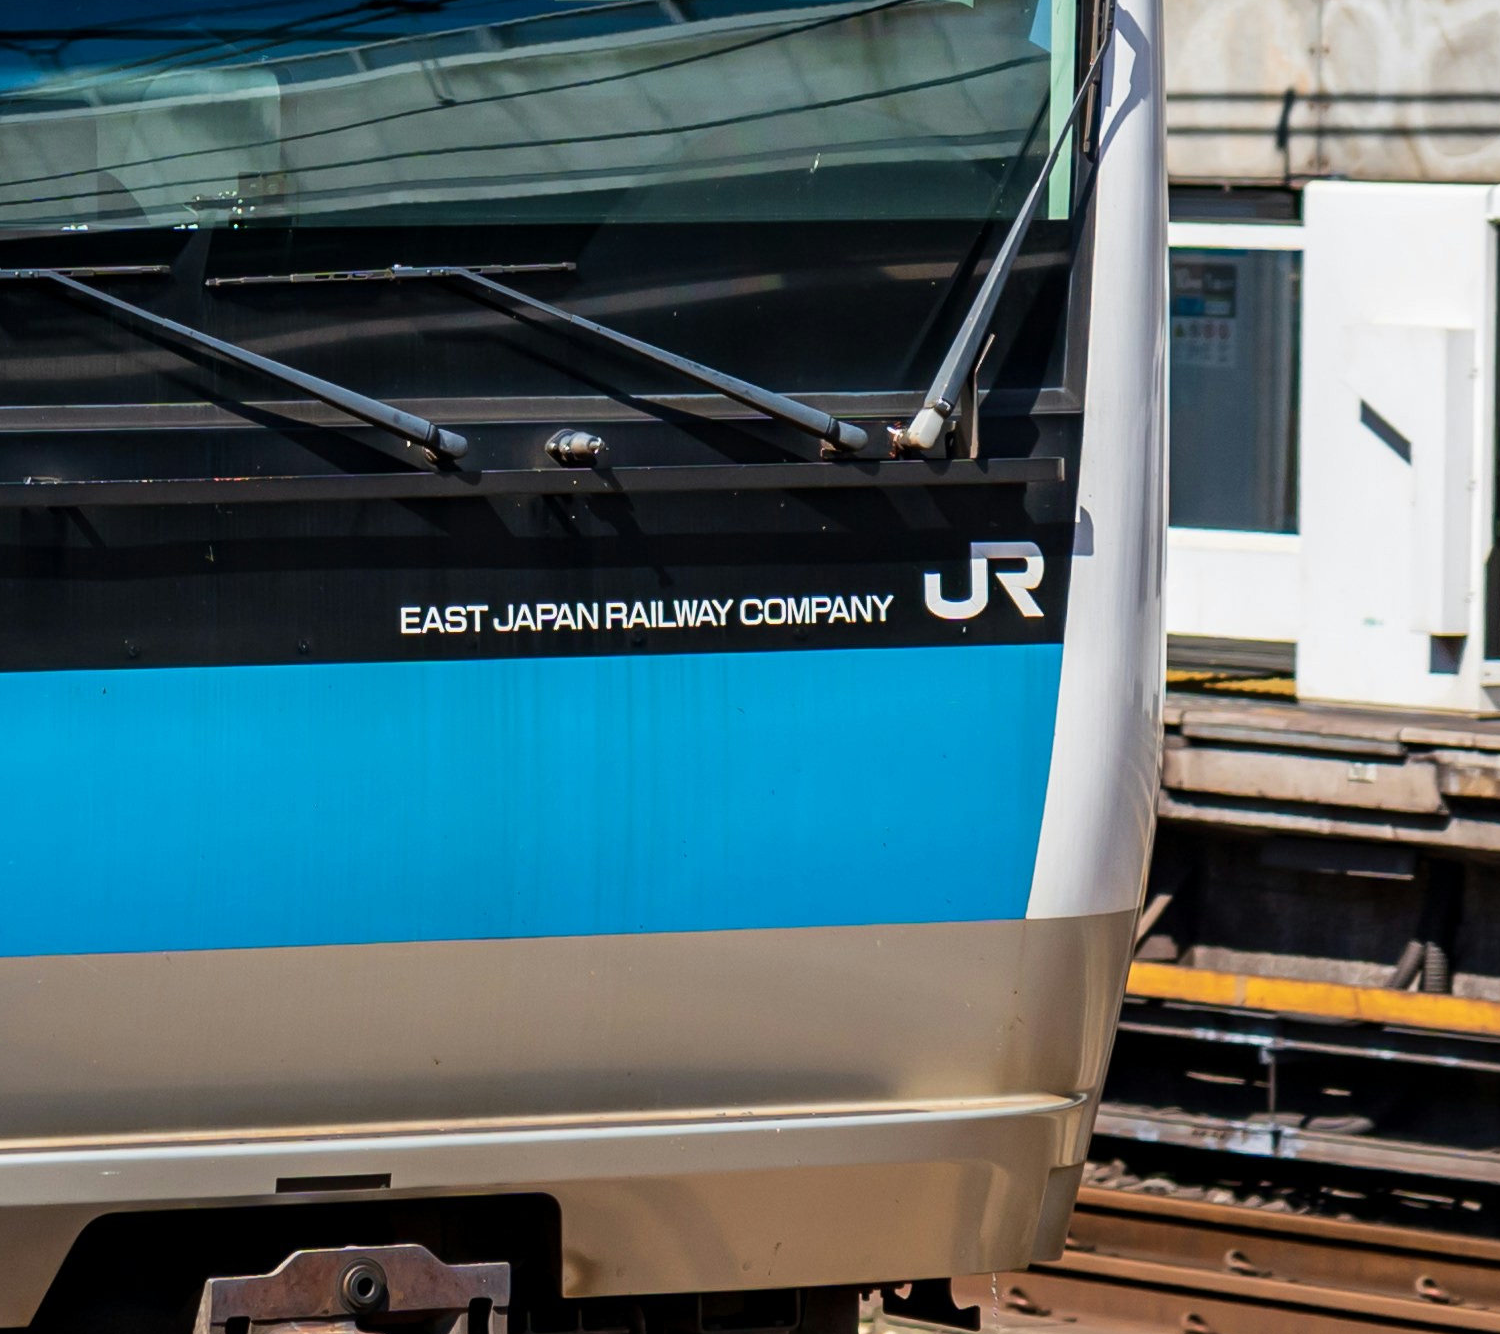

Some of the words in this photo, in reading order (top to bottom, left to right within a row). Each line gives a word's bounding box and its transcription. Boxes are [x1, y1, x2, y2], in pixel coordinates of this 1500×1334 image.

[924, 541, 1045, 618] JR
[400, 604, 489, 634] EAST
[493, 601, 600, 632] JAPAN
[605, 598, 734, 628] RAILWAY
[740, 594, 894, 625] COMPANY
